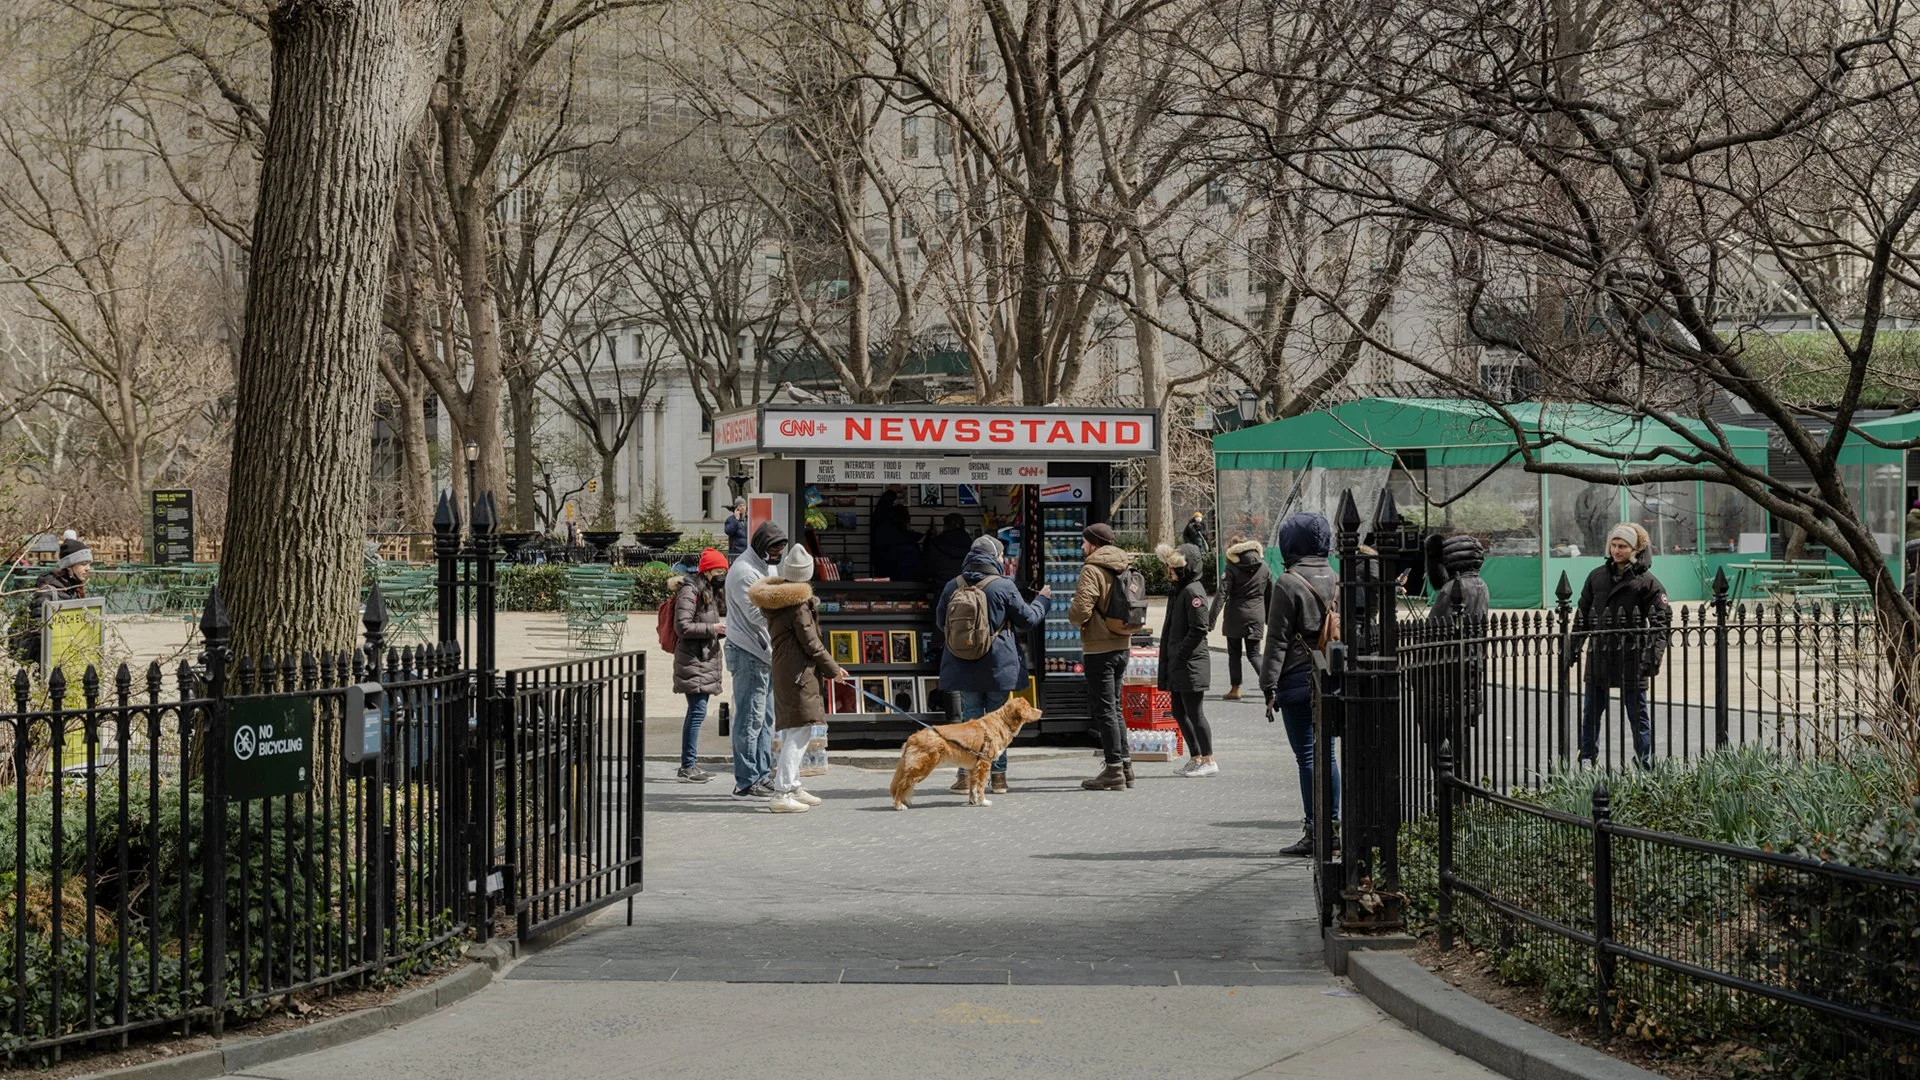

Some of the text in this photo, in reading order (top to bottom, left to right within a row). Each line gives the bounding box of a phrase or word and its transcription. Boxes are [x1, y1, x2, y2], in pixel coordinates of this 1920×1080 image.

[779, 416, 1141, 444] CNN+ NEWSSTAND
[844, 461, 875, 469] INTERACTIVE
[884, 461, 896, 469] FOOD
[916, 461, 926, 469] POP
[968, 461, 990, 471] ORIGINAL
[818, 466, 834, 474] NEWS
[939, 466, 960, 475] HISTORY
[997, 467, 1012, 476] FILMS
[1018, 466, 1044, 477] CNN+
[817, 474, 836, 482] SHOWS
[910, 472, 931, 480] CULTURE
[971, 472, 988, 480] SERIES
[259, 724, 273, 739] NO
[259, 737, 303, 756] BICYCLING
